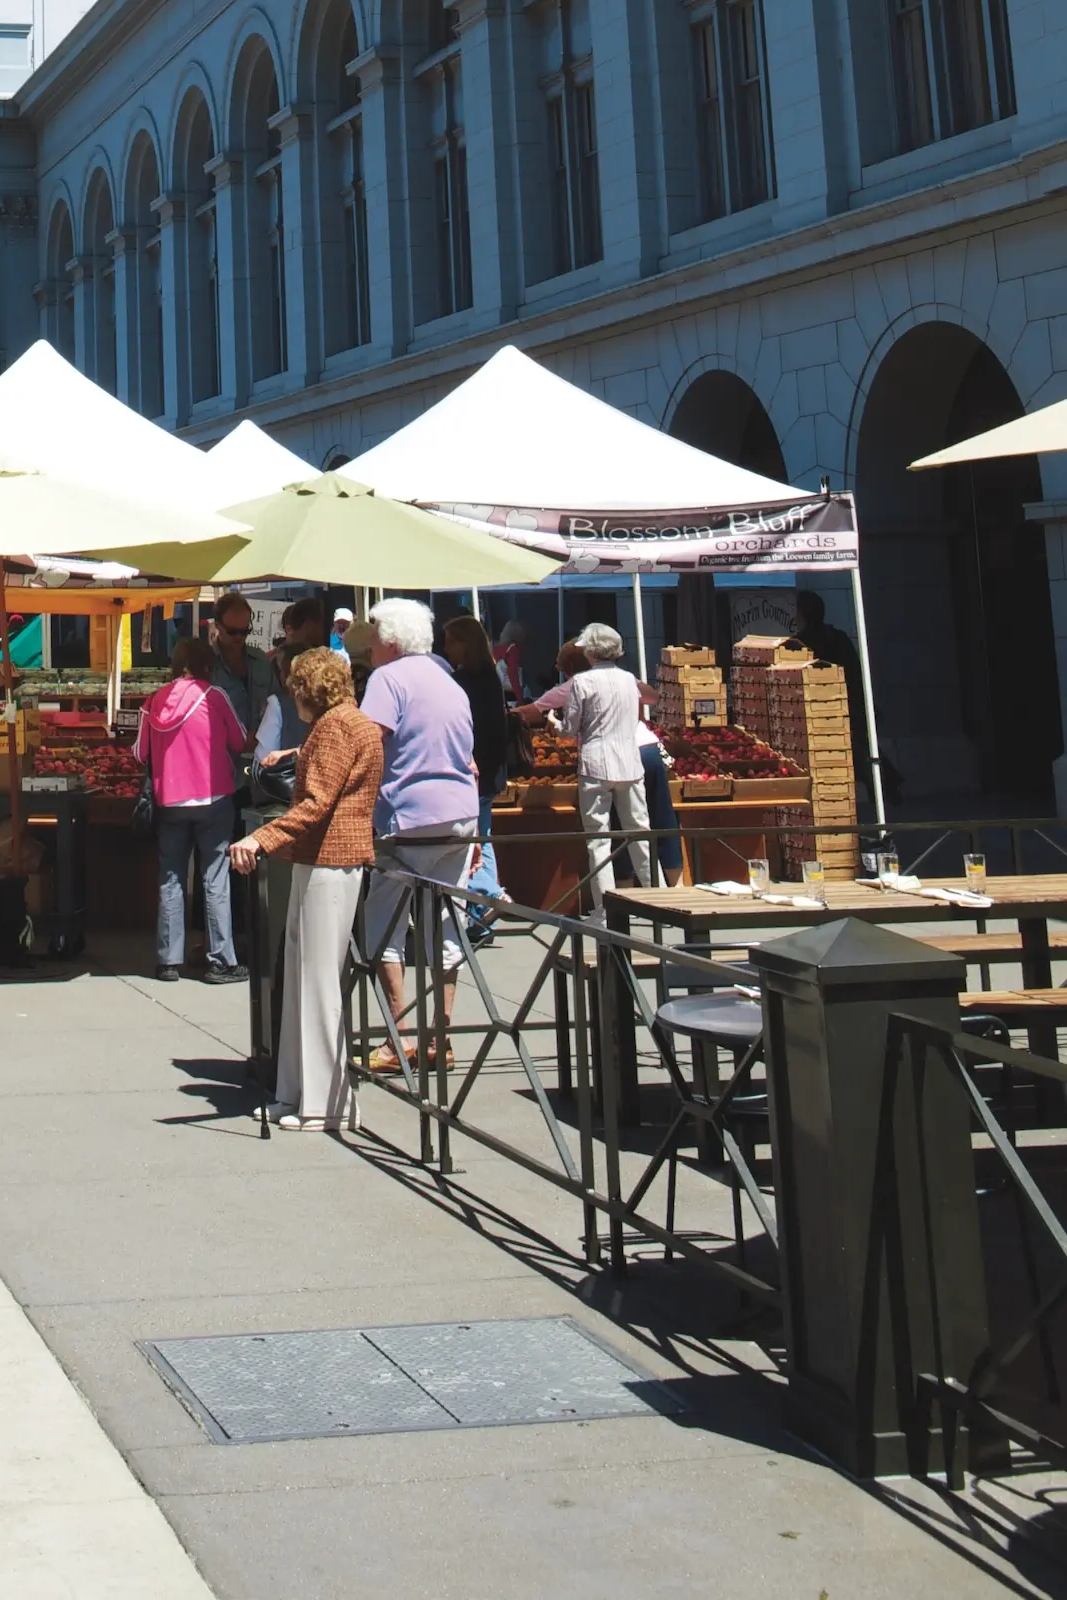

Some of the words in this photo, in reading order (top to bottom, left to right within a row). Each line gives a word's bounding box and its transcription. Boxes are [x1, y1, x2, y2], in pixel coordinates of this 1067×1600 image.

[569, 517, 714, 541] Blossom
[727, 504, 813, 535] Bluff
[715, 534, 837, 552] orchards
[701, 555, 727, 565] Organic
[772, 552, 784, 561] the
[785, 553, 812, 561] Loewen
[813, 551, 835, 562] family
[836, 550, 856, 559] farm.
[762, 599, 801, 634] Gourme
